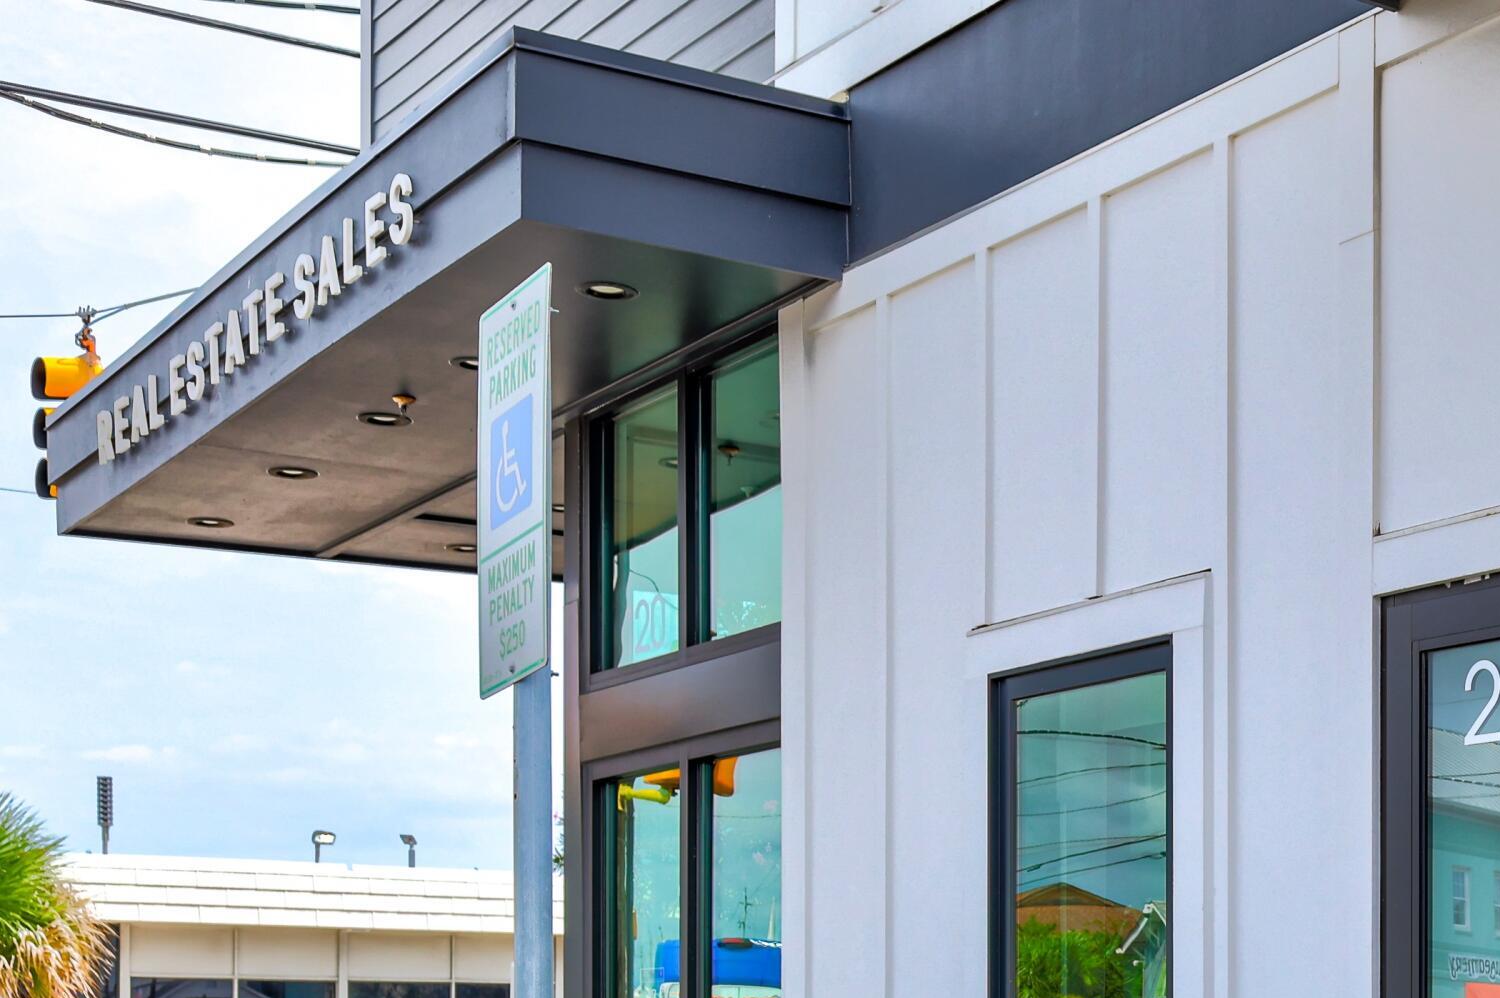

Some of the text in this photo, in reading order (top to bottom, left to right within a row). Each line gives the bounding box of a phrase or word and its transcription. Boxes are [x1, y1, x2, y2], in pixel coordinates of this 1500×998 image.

[96, 172, 414, 465] REAL ESTATE SALES
[487, 300, 541, 371] RESERVED
[489, 344, 537, 409] PARKING
[487, 540, 536, 594] MAXIMUM
[489, 574, 535, 627] PENALTY
[499, 622, 526, 661] $250
